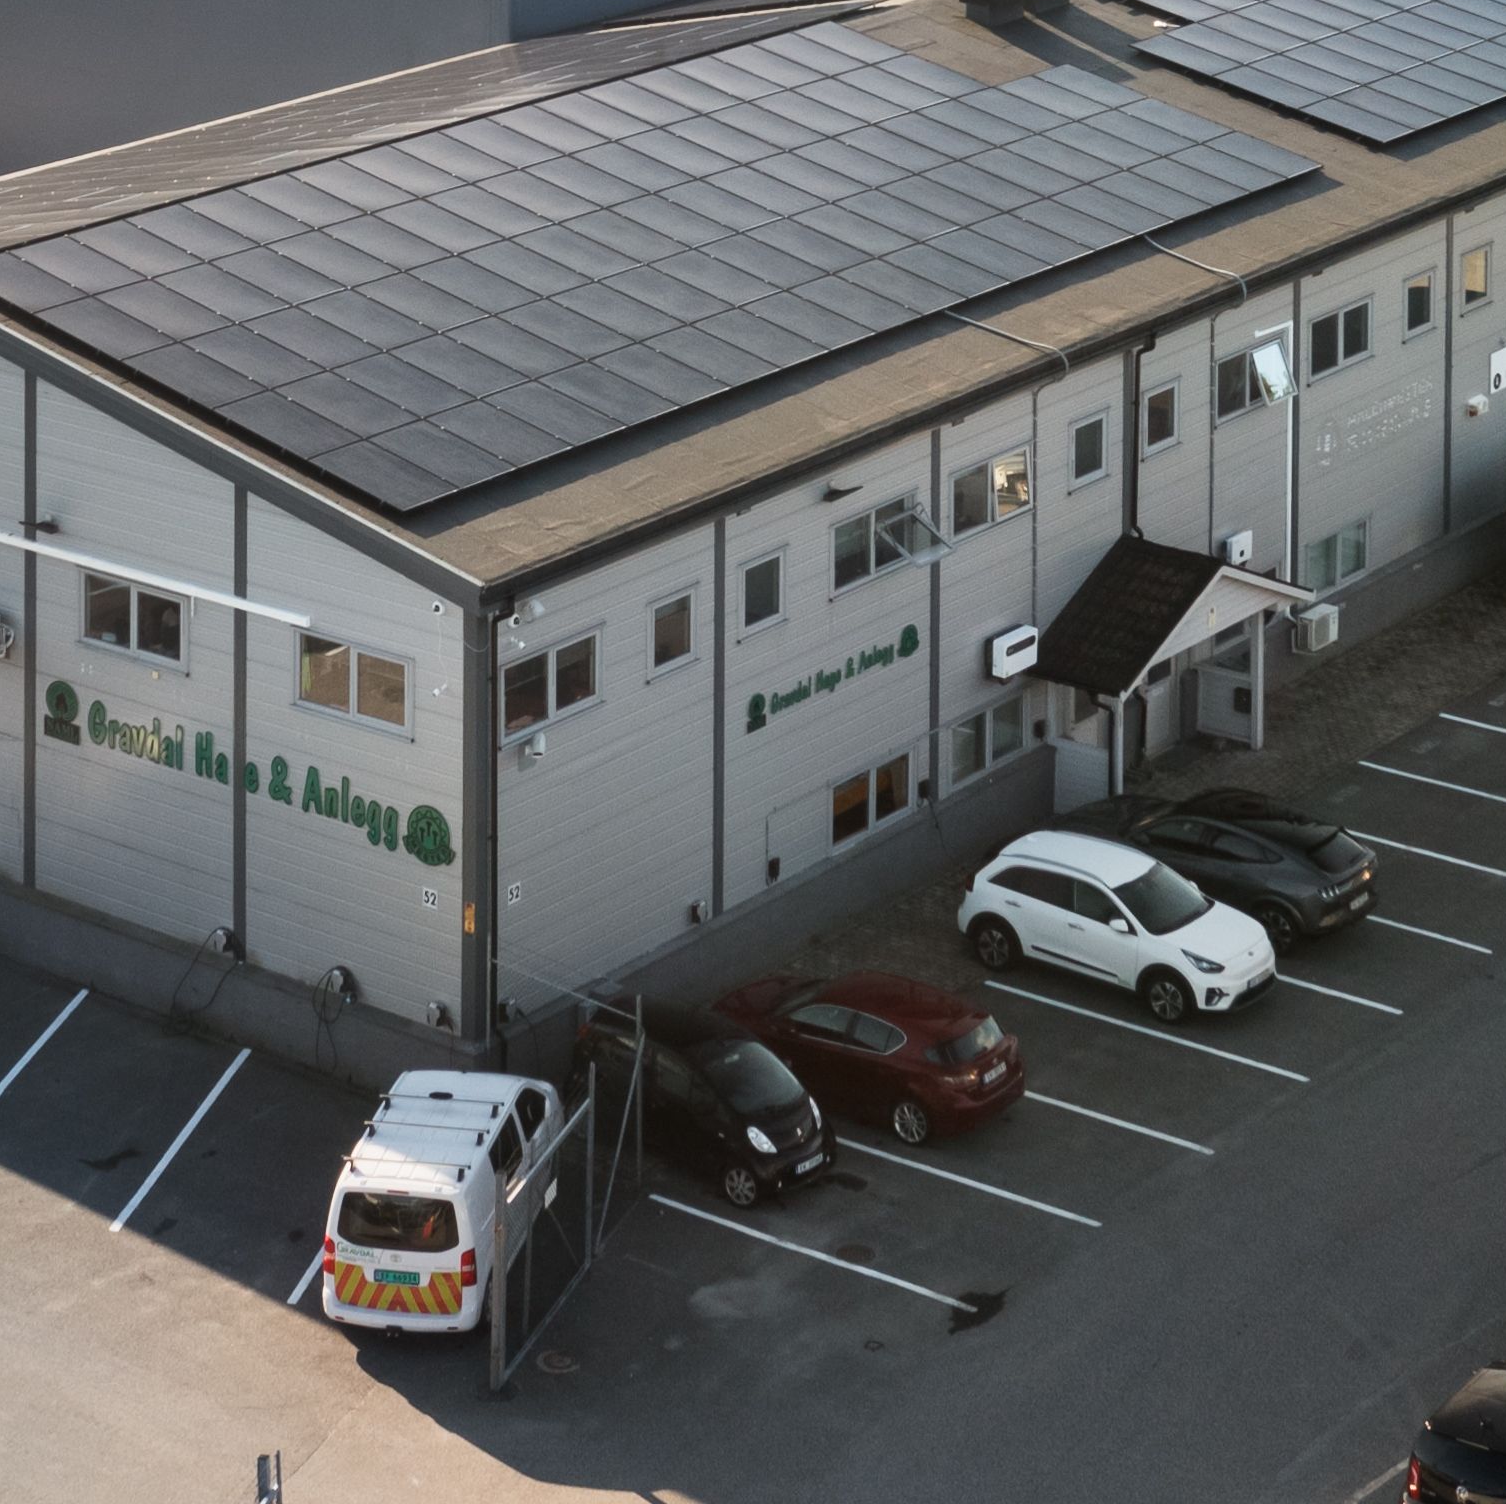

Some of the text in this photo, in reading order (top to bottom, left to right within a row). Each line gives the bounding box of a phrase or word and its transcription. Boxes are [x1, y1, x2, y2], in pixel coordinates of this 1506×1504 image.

[88, 700, 184, 771] Gravdal
[195, 730, 260, 794] Hae
[268, 754, 293, 806] &
[301, 765, 399, 852] Anlegg
[423, 890, 437, 906] 52
[508, 885, 520, 902] 52
